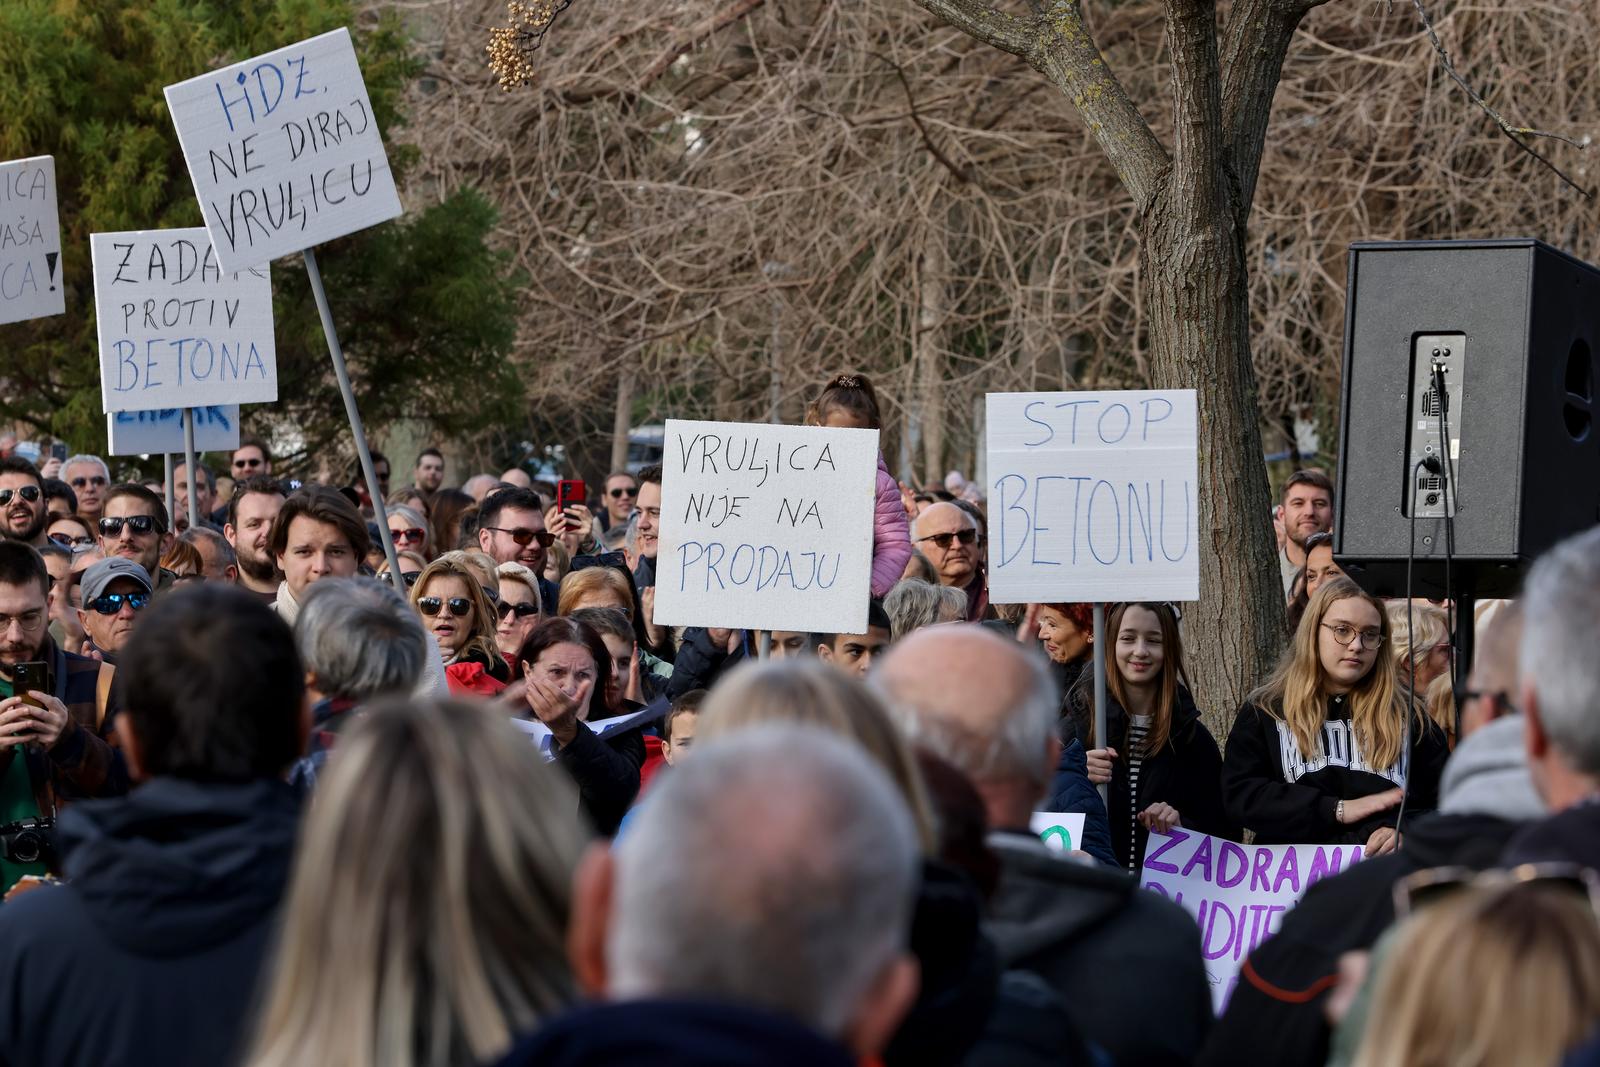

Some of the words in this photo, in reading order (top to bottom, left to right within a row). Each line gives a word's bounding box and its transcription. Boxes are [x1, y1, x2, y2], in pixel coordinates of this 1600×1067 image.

[209, 133, 265, 184] NE
[281, 99, 368, 162] DIRAJ
[0, 216, 44, 249] AŠA
[112, 240, 267, 285] ZADA
[121, 298, 240, 334] PROTIV
[113, 338, 267, 392] BETONA
[1023, 398, 1173, 446] STOP
[776, 498, 824, 529] NA
[994, 474, 1190, 568] BETONU
[677, 541, 841, 592] PRODAJU
[1145, 881, 1287, 961] DITE
